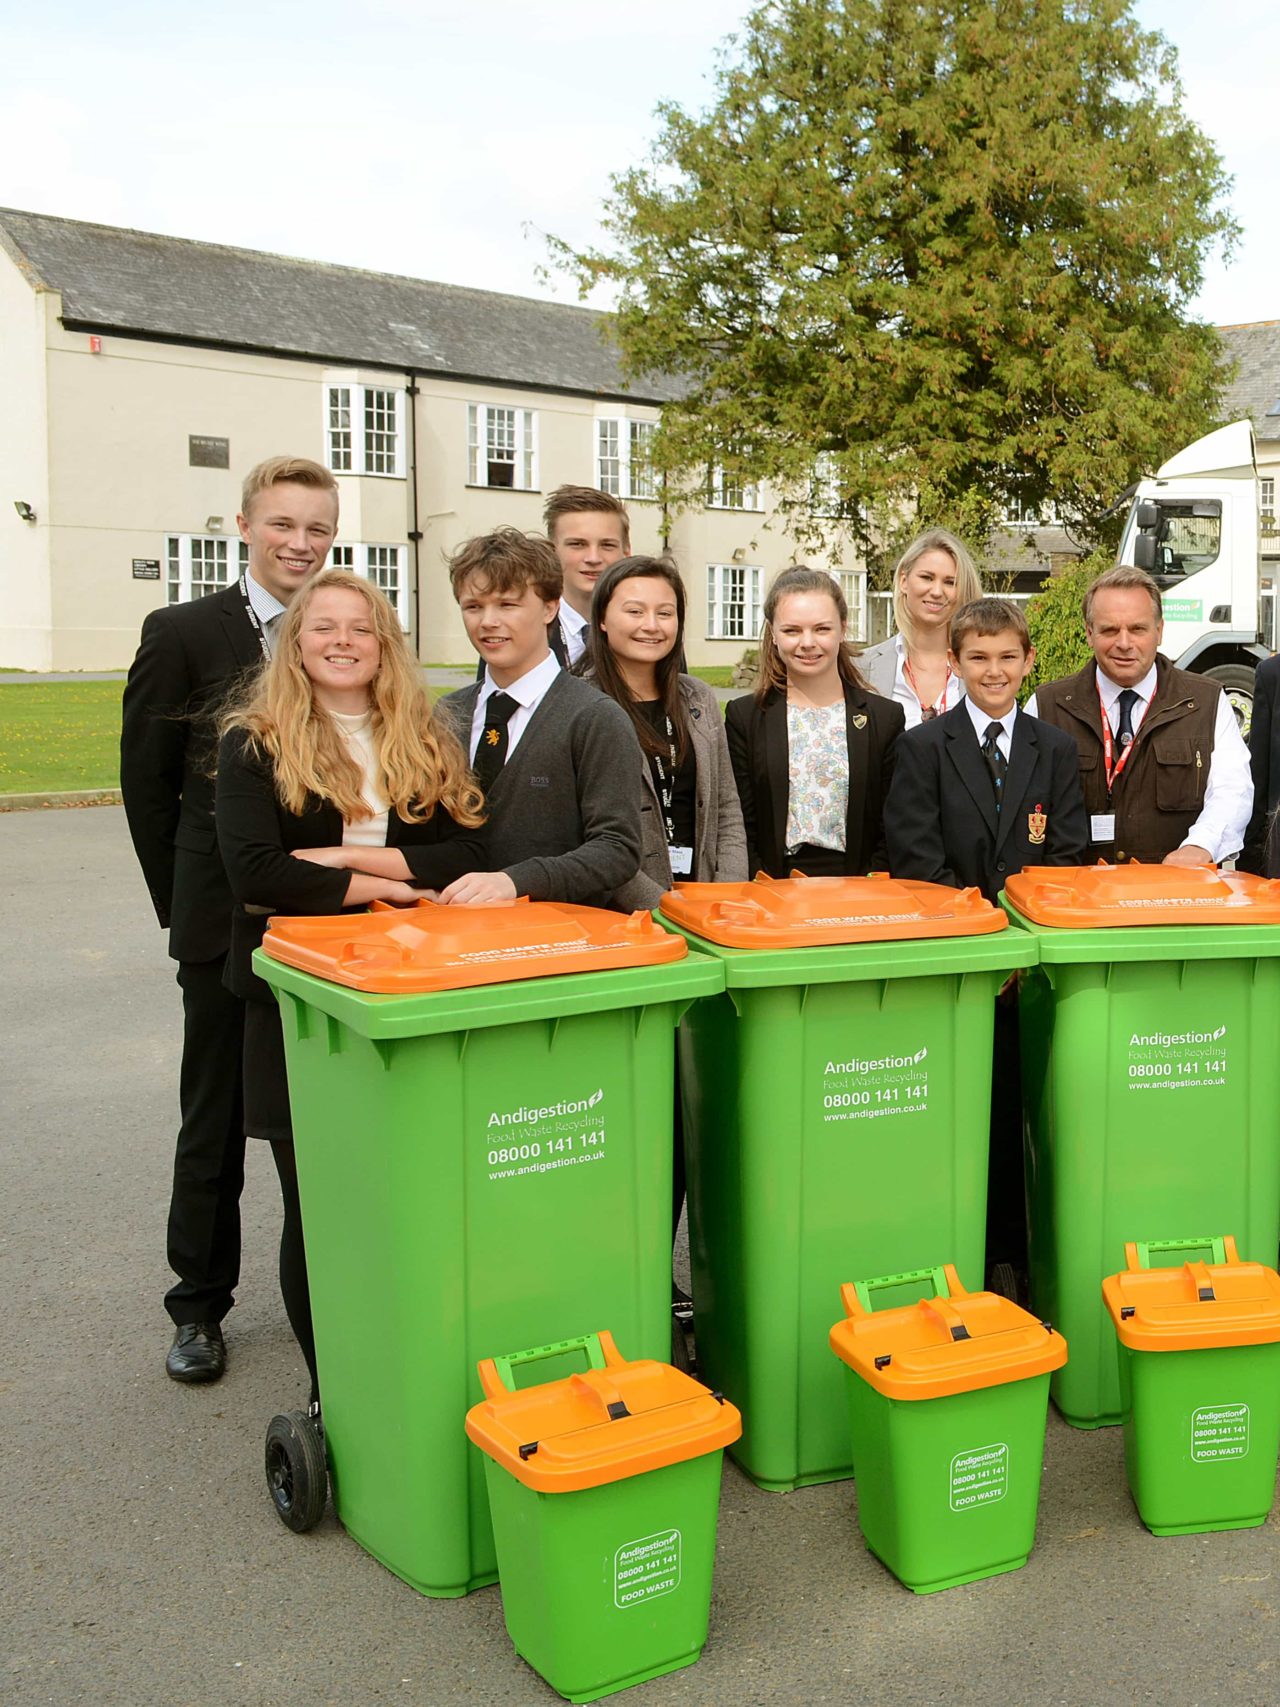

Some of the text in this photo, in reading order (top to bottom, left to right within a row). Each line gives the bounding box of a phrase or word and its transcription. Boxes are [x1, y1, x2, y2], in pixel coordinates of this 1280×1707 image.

[244, 605, 260, 629] STUDENT
[458, 948, 500, 958] FOOD
[501, 944, 551, 954] WASTE
[1129, 1030, 1212, 1048] Andigestion
[1128, 1046, 1226, 1060] Food Waste Recycling
[824, 1055, 912, 1075] Andigestion
[1128, 1060, 1226, 1077] 08000 141 141
[824, 1070, 928, 1090] Food Waste Recycling
[1128, 1077, 1225, 1090] www.andigestion.co.uk
[824, 1084, 928, 1108] 08000 141 141
[487, 1100, 588, 1128] Andigestion
[824, 1102, 928, 1122] www.andigestion.co.uk
[487, 1114, 604, 1144] Food Waste Recycling
[488, 1130, 605, 1164] 08000 141 141
[488, 1150, 605, 1180] www.andigestion.co.uk
[1196, 1411, 1240, 1420] Andigestion
[1194, 1428, 1216, 1438] 08000
[955, 1452, 998, 1468] Andigestion
[1197, 1446, 1244, 1458] FOOD WASTE
[953, 1466, 1004, 1486] 08000 141 141
[956, 1488, 1002, 1506] FOOD WASTE
[620, 1540, 668, 1560] Andigestion
[618, 1554, 677, 1580] 08000 141 141
[622, 1578, 675, 1603] FOOD WASTE
